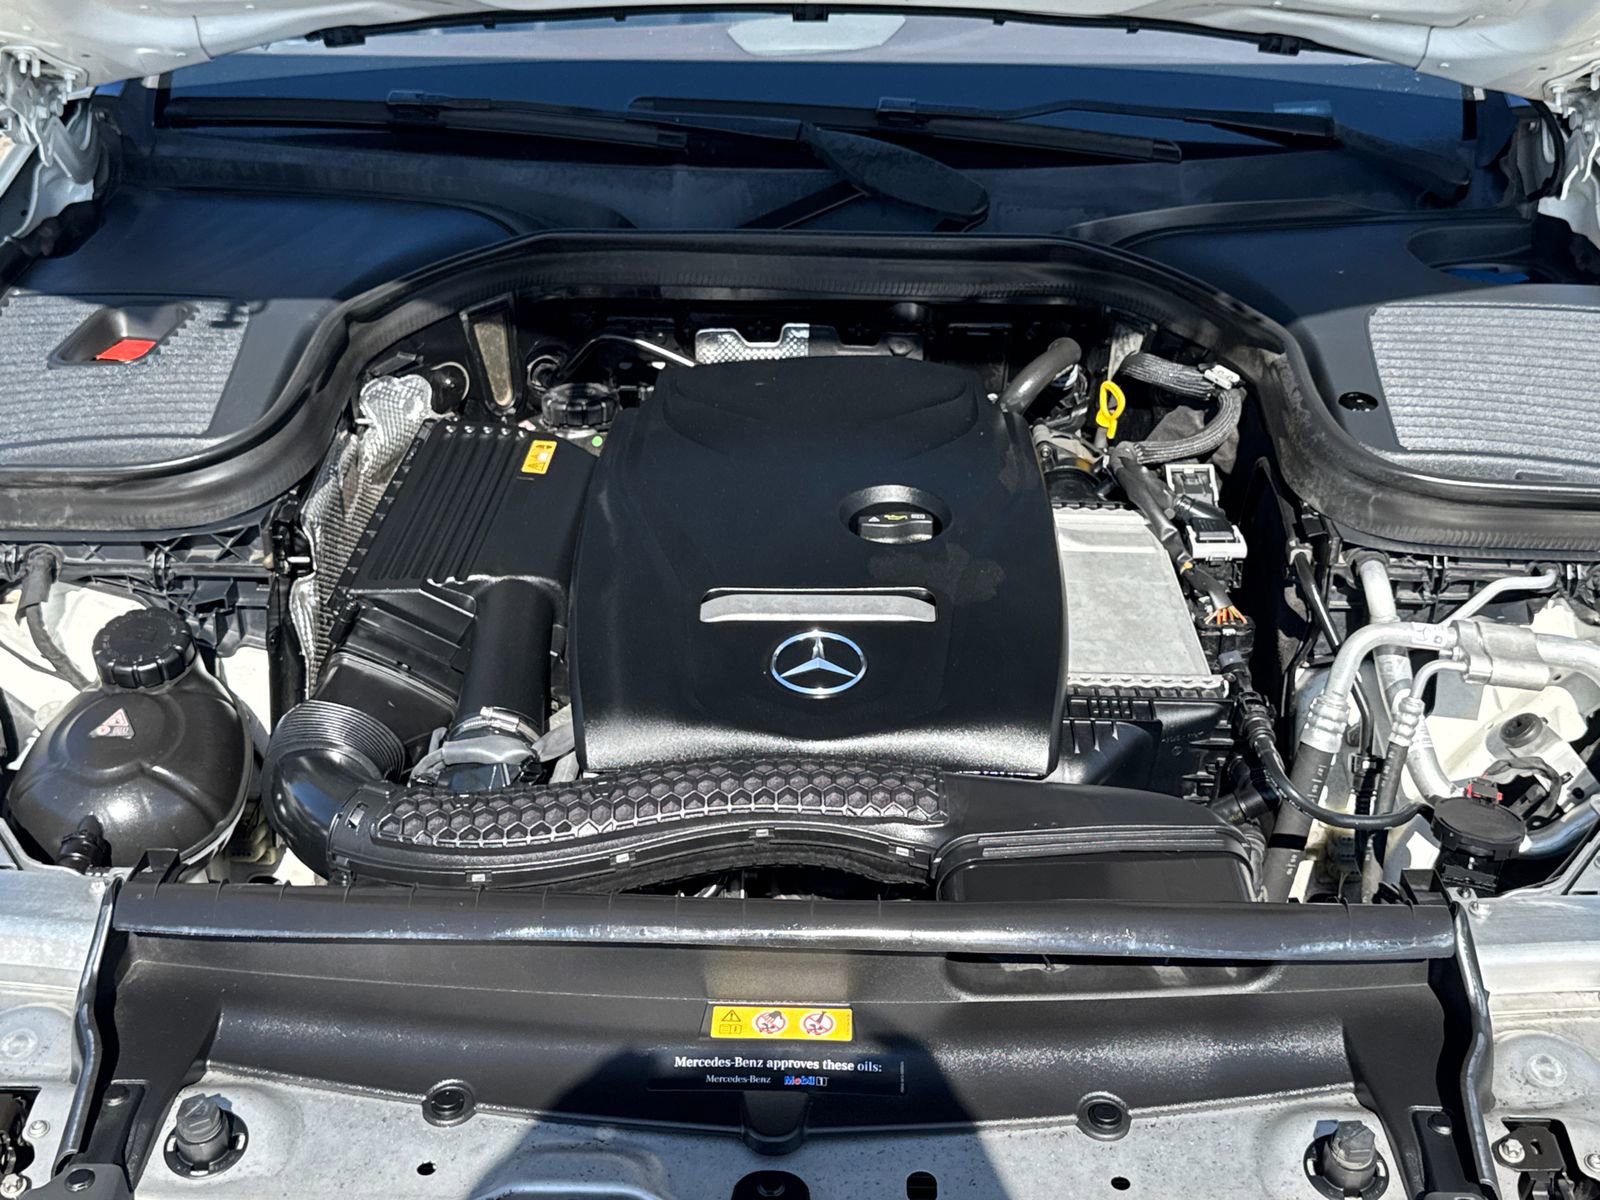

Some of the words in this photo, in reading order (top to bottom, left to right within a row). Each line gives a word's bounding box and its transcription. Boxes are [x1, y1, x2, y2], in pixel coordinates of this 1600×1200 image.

[674, 1056, 764, 1068] Mercedes-Benz
[766, 1059, 820, 1071] approves
[822, 1059, 855, 1071] these
[857, 1061, 883, 1073] oils:
[705, 1074, 772, 1084] Mercedes-Benz
